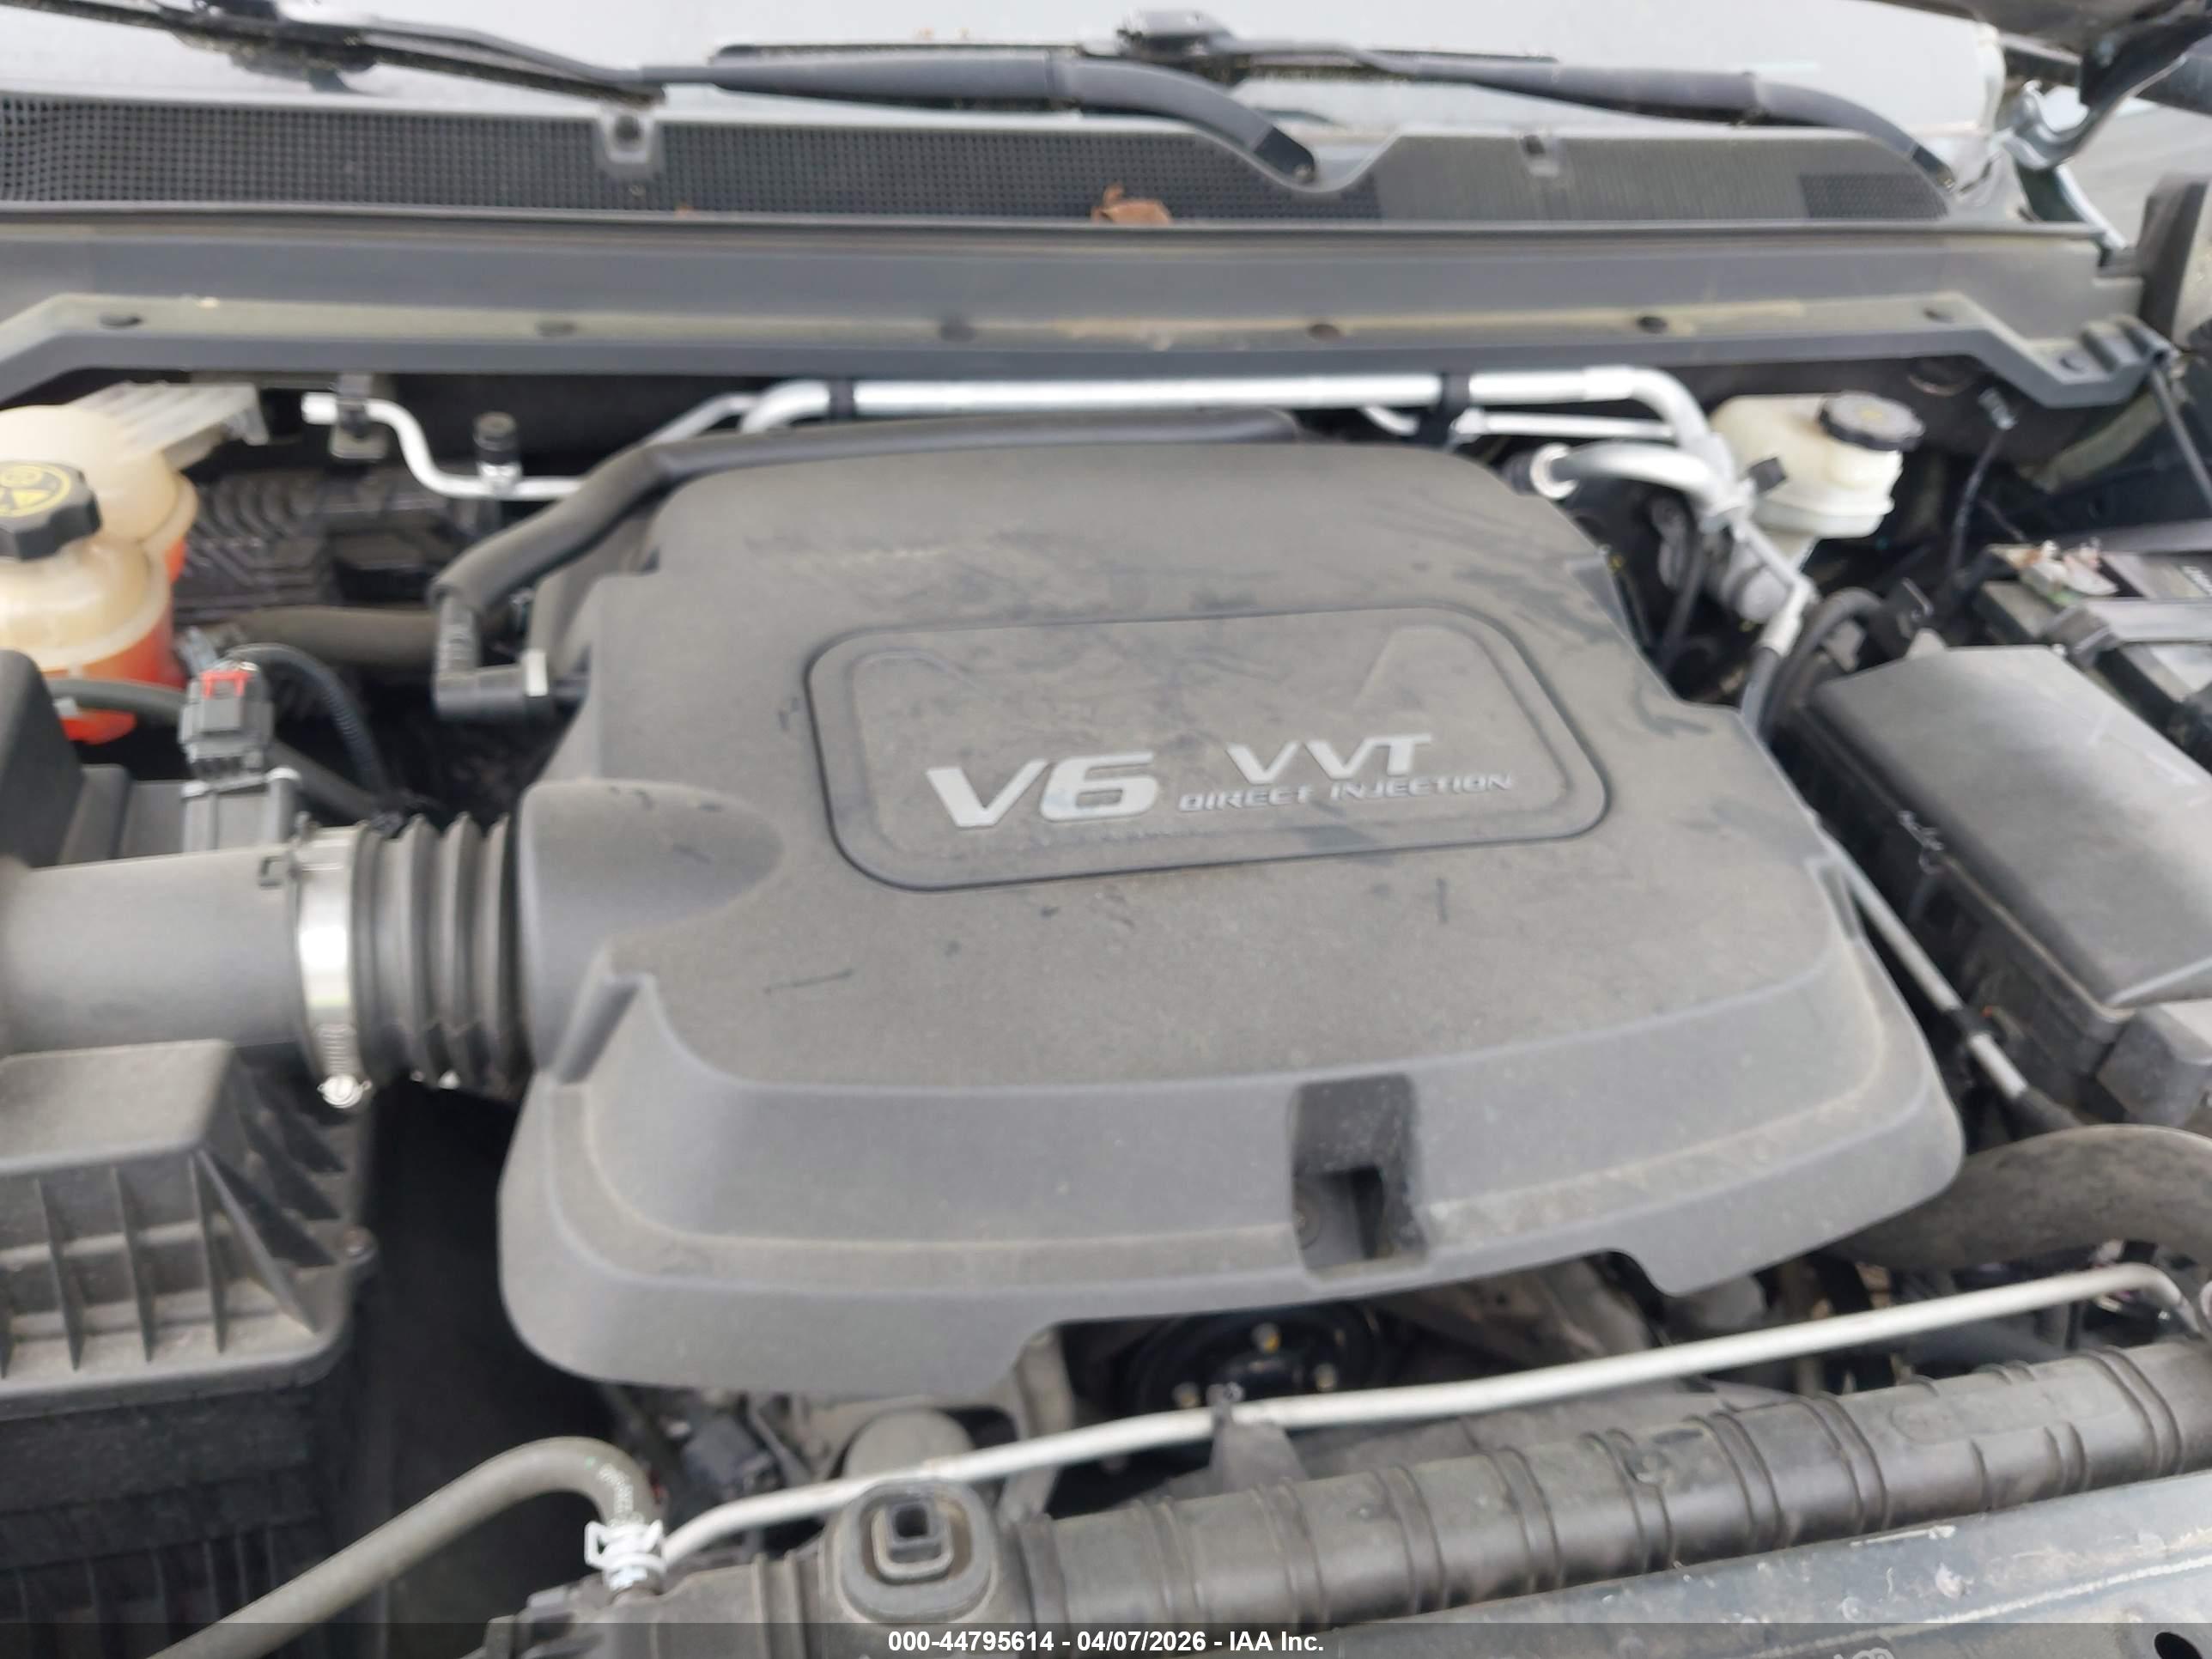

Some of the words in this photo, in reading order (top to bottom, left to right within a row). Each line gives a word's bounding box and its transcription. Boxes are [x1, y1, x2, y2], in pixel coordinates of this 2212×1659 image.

[1225, 732, 1433, 785] VVT
[925, 750, 1160, 829] V6
[1178, 782, 1314, 813] DIRECT
[1329, 772, 1514, 801] INJECTION
